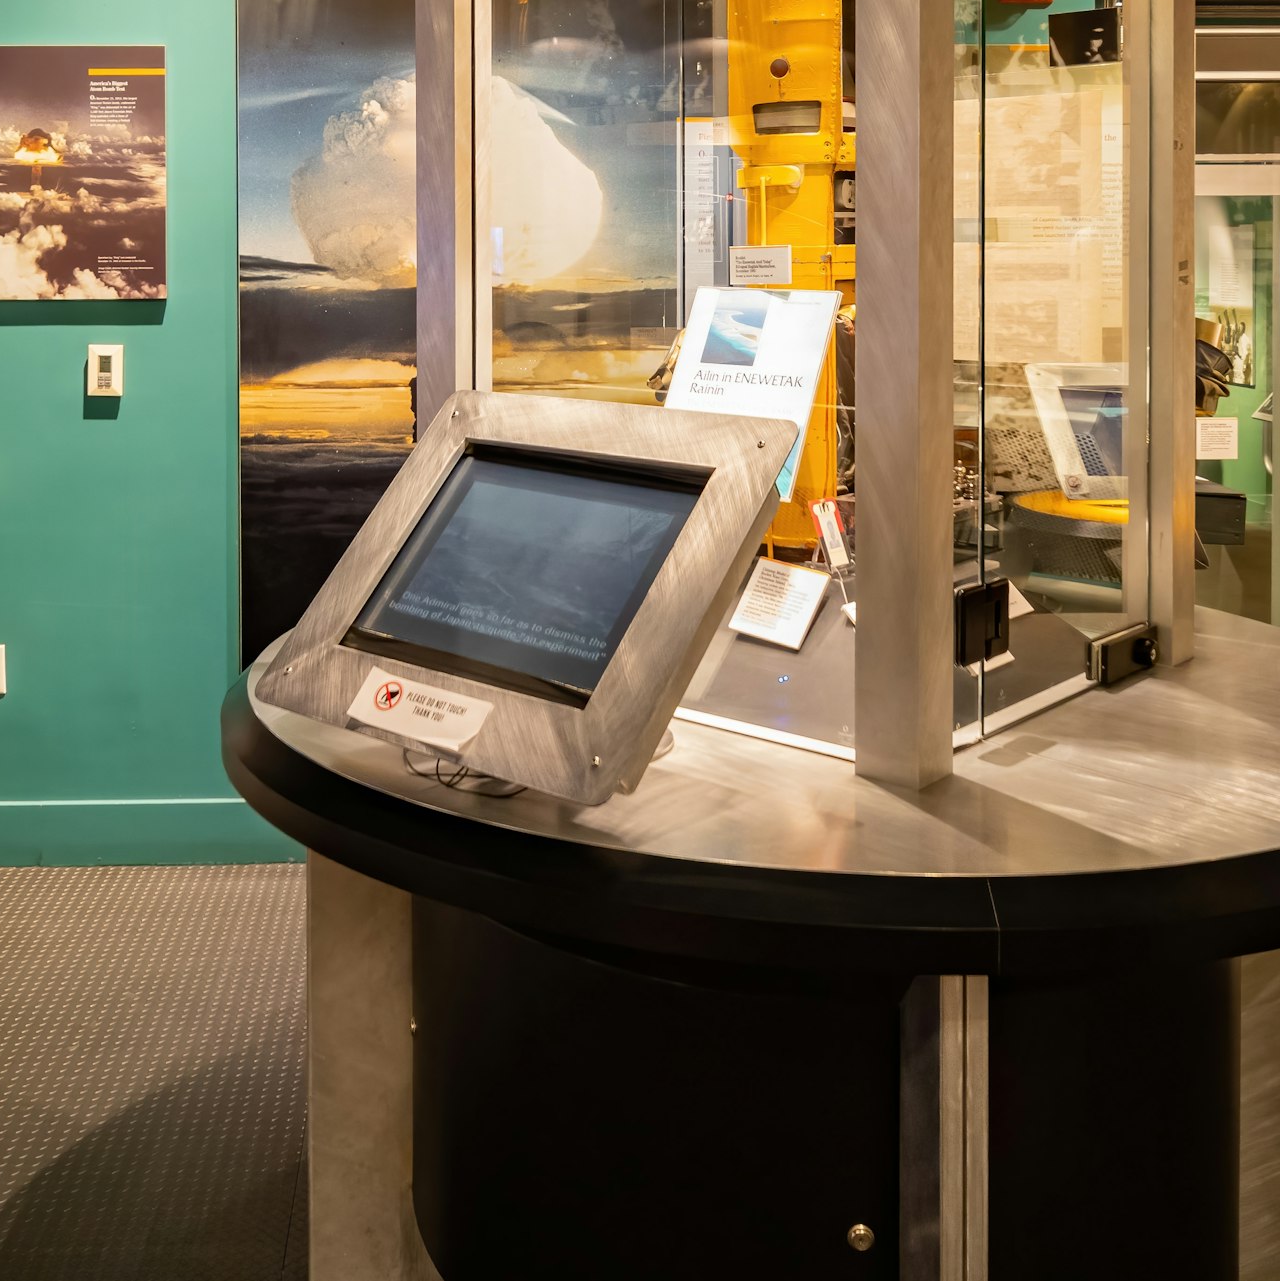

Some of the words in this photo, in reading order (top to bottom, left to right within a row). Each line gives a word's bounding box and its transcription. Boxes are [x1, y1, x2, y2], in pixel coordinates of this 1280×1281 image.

[690, 382, 724, 396] Rainin
[694, 370, 719, 382] Ailin
[722, 371, 732, 383] in
[734, 372, 803, 388] ENEWETAK
[389, 600, 428, 619] bombing
[431, 610, 442, 620] of
[442, 611, 471, 629] Japan
[402, 591, 421, 602] One
[423, 595, 459, 612] Admiral
[460, 606, 483, 619] goes
[486, 613, 499, 621] so
[500, 614, 513, 625] far
[516, 620, 529, 629] as
[531, 623, 542, 632] to
[544, 626, 586, 644] dismiss
[589, 636, 607, 649] the
[406, 692, 426, 703] PLEASE
[426, 697, 434, 706] DO
[435, 699, 447, 709] NOT
[447, 702, 467, 716] TOUCH!
[413, 706, 430, 718] THANK
[431, 711, 445, 722] YOU!
